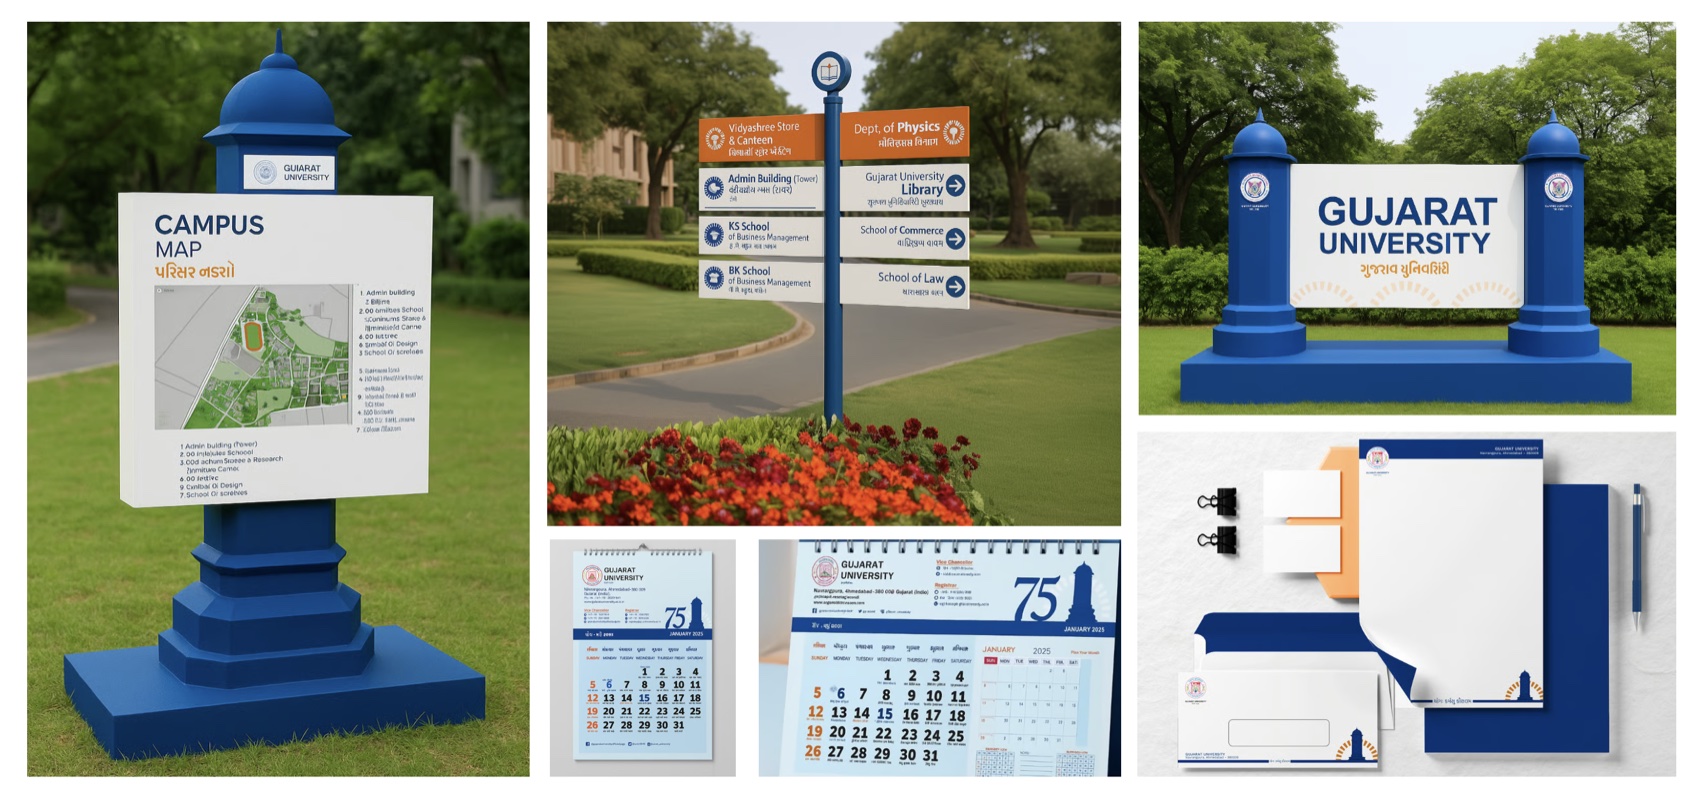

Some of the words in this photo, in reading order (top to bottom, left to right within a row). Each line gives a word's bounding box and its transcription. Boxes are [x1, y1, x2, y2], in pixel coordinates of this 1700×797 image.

[729, 123, 775, 134] Vidyashree
[777, 122, 800, 131] Store
[883, 122, 894, 133] of
[897, 121, 940, 135] Physics
[729, 136, 735, 145] &
[737, 136, 773, 145] Canteen
[728, 174, 756, 183] Admin
[758, 174, 792, 185] Building
[793, 175, 818, 185] (Tower)
[865, 172, 897, 184] Gujarat
[900, 171, 944, 183] University
[901, 183, 944, 197] Library
[1318, 196, 1497, 226] GUJARAT
[155, 214, 264, 235] CAMPUS
[729, 222, 740, 231] KS
[742, 221, 770, 231] School
[860, 225, 887, 235] School
[889, 225, 897, 235] of
[899, 226, 944, 235] Commerce
[737, 233, 766, 241] Business
[767, 233, 809, 243] Management
[1319, 233, 1491, 255] UNIVERSITY
[156, 241, 201, 258] MAP
[729, 266, 740, 275] BK
[742, 266, 771, 276] School
[737, 277, 766, 286] Business
[767, 278, 811, 288] Management
[879, 272, 909, 282] School
[912, 273, 922, 283] of
[924, 273, 944, 284] Law
[841, 560, 884, 569] GUJARAT
[840, 572, 894, 580] UNIVERSITY
[1014, 575, 1061, 622] 75
[665, 606, 686, 629] 75
[642, 668, 647, 676] 1
[659, 668, 665, 676] 2
[676, 668, 682, 676] 3
[692, 668, 699, 676] 4
[884, 669, 891, 681] 1
[909, 669, 917, 682] 2
[932, 670, 940, 682] 3
[955, 671, 964, 682] 4
[587, 694, 599, 702] 12
[603, 694, 615, 702] 13
[621, 694, 632, 702] 14
[639, 694, 650, 702] 15
[656, 694, 668, 702] 16
[673, 694, 685, 702] 17
[690, 694, 701, 702] 18
[813, 687, 821, 698] 5
[837, 687, 845, 699] 6
[859, 688, 867, 700] 7
[882, 689, 891, 700] 8
[907, 690, 916, 701] 9
[926, 690, 942, 702] 10
[951, 691, 966, 703] 11
[587, 707, 599, 715] 19
[603, 707, 615, 715] 20
[621, 707, 632, 715] 21
[639, 707, 650, 715] 22
[656, 707, 668, 715] 23
[673, 707, 685, 715] 24
[690, 707, 701, 715] 25
[808, 706, 823, 717] 12
[831, 706, 847, 718] 13
[854, 707, 870, 719] 14
[877, 708, 893, 720] 15
[903, 709, 919, 721] 16
[925, 709, 941, 721] 17
[949, 710, 966, 722] 18
[587, 721, 599, 729] 26
[603, 721, 615, 729] 27
[621, 721, 632, 729] 28
[639, 721, 650, 729] 29
[656, 721, 668, 729] 30
[673, 721, 685, 729] 31
[807, 725, 822, 737] 19
[829, 726, 846, 738] 20
[852, 727, 868, 739] 21
[875, 727, 892, 739] 22
[901, 729, 918, 741] 23
[924, 729, 940, 742] 24
[948, 730, 964, 742] 25
[805, 745, 821, 757] 26
[828, 746, 844, 758] 27
[850, 747, 867, 759] 28
[874, 747, 890, 760] 29
[900, 749, 916, 761] 30
[922, 750, 938, 762] 31
